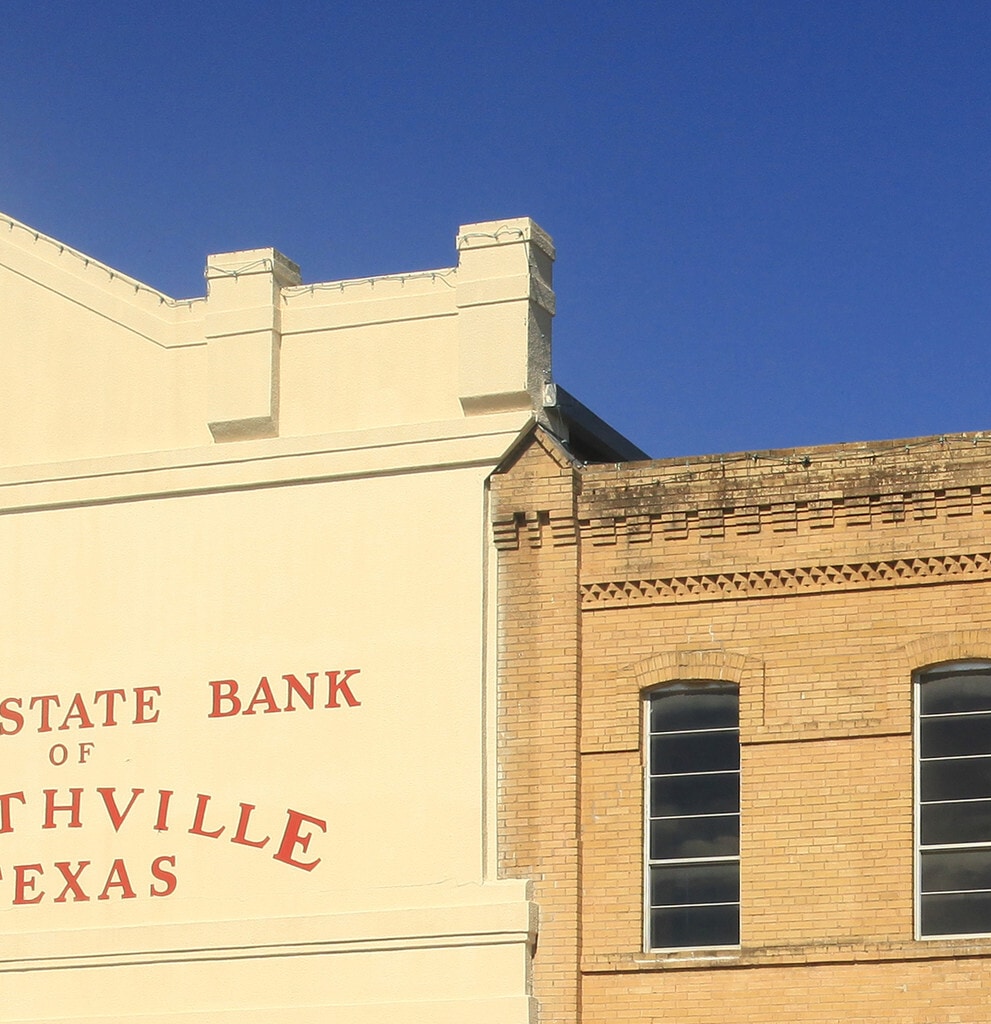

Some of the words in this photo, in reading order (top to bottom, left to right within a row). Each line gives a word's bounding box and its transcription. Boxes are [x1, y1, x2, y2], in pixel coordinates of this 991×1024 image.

[0, 686, 162, 735] STATE
[208, 669, 362, 718] BANK
[48, 742, 95, 766] OF
[0, 855, 178, 905] EXAS
